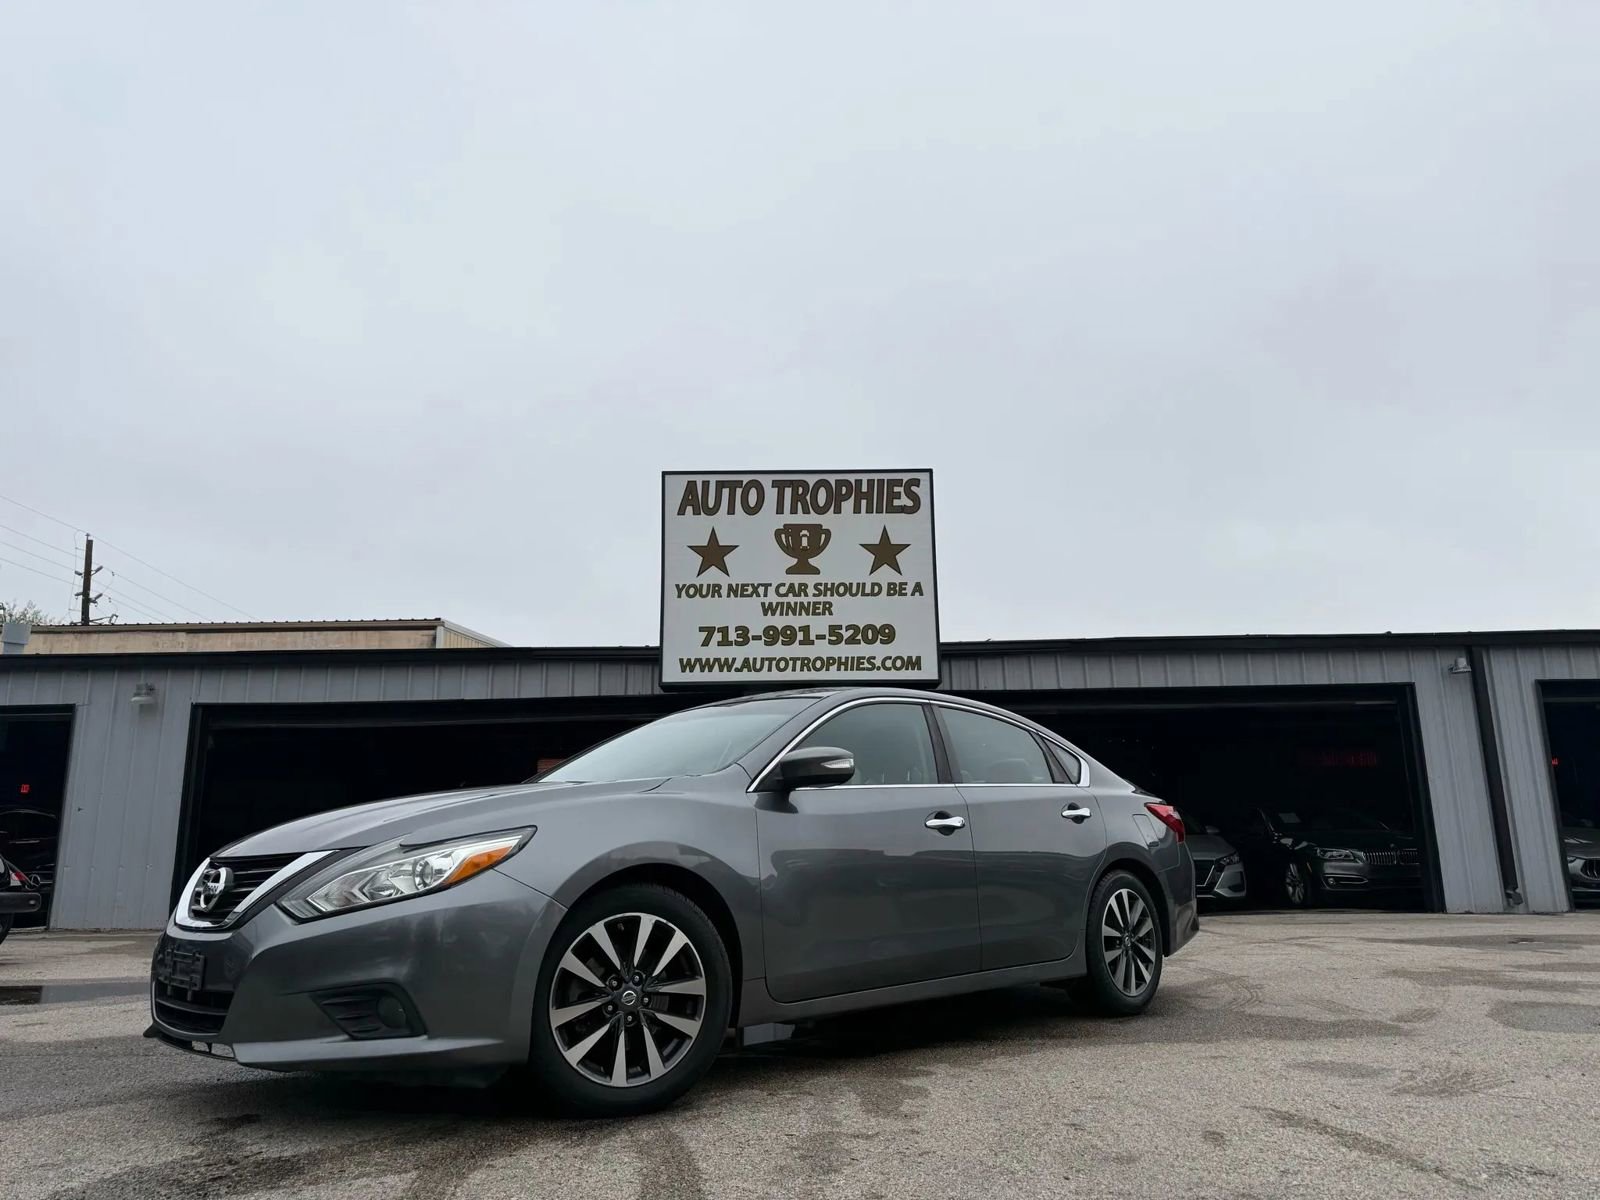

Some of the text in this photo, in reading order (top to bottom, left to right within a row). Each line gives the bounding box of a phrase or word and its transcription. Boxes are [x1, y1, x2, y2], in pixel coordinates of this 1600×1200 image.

[677, 478, 921, 516] AUTO TROPHIES
[675, 582, 924, 598] YOUR NEXT CAR SHOULD BE A
[761, 601, 833, 617] WINNER
[698, 624, 896, 647] 713-991-5209
[679, 656, 922, 673] WWW.AUTOTROPHIES.COM
